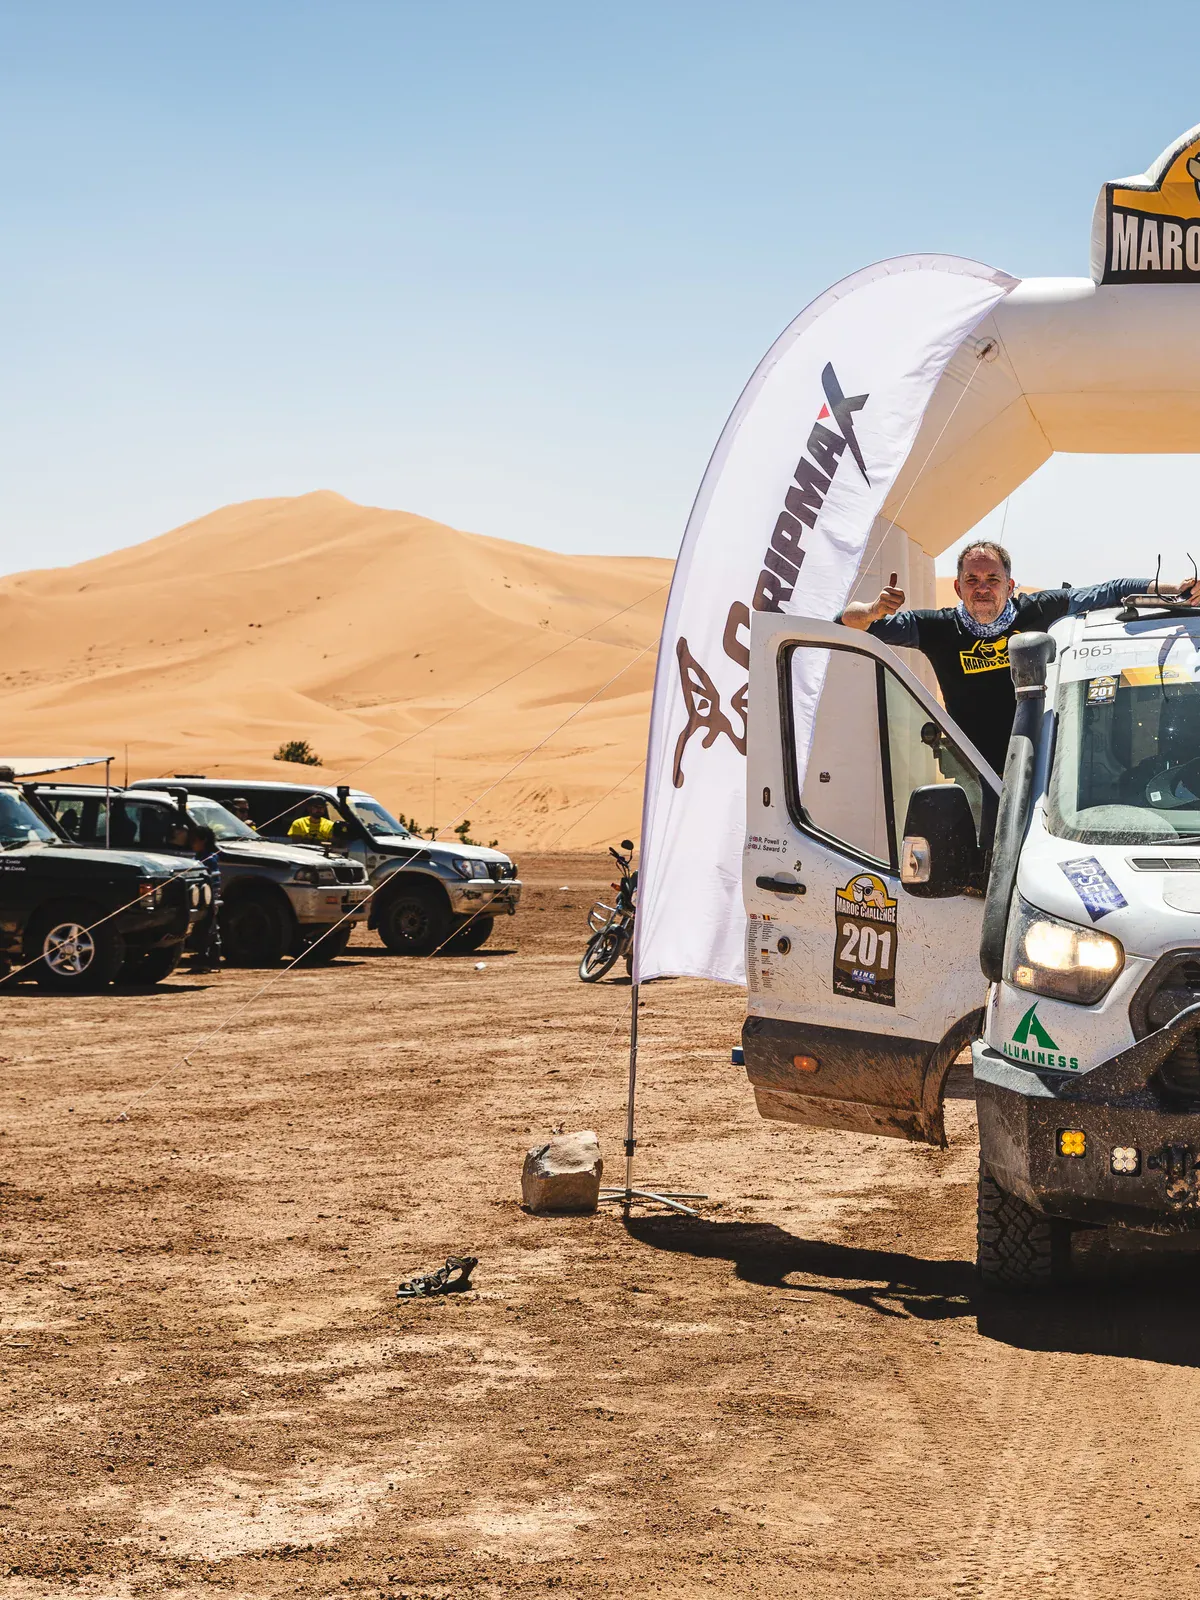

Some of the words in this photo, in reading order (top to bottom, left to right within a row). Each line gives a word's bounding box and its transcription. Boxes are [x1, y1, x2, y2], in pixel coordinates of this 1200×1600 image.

[1072, 644, 1112, 660] 1965
[1090, 686, 1113, 697] 201
[836, 895, 859, 916] MAROC
[840, 922, 891, 969] 201
[853, 970, 875, 979] KING
[1003, 1042, 1078, 1069] ALUMINESS
